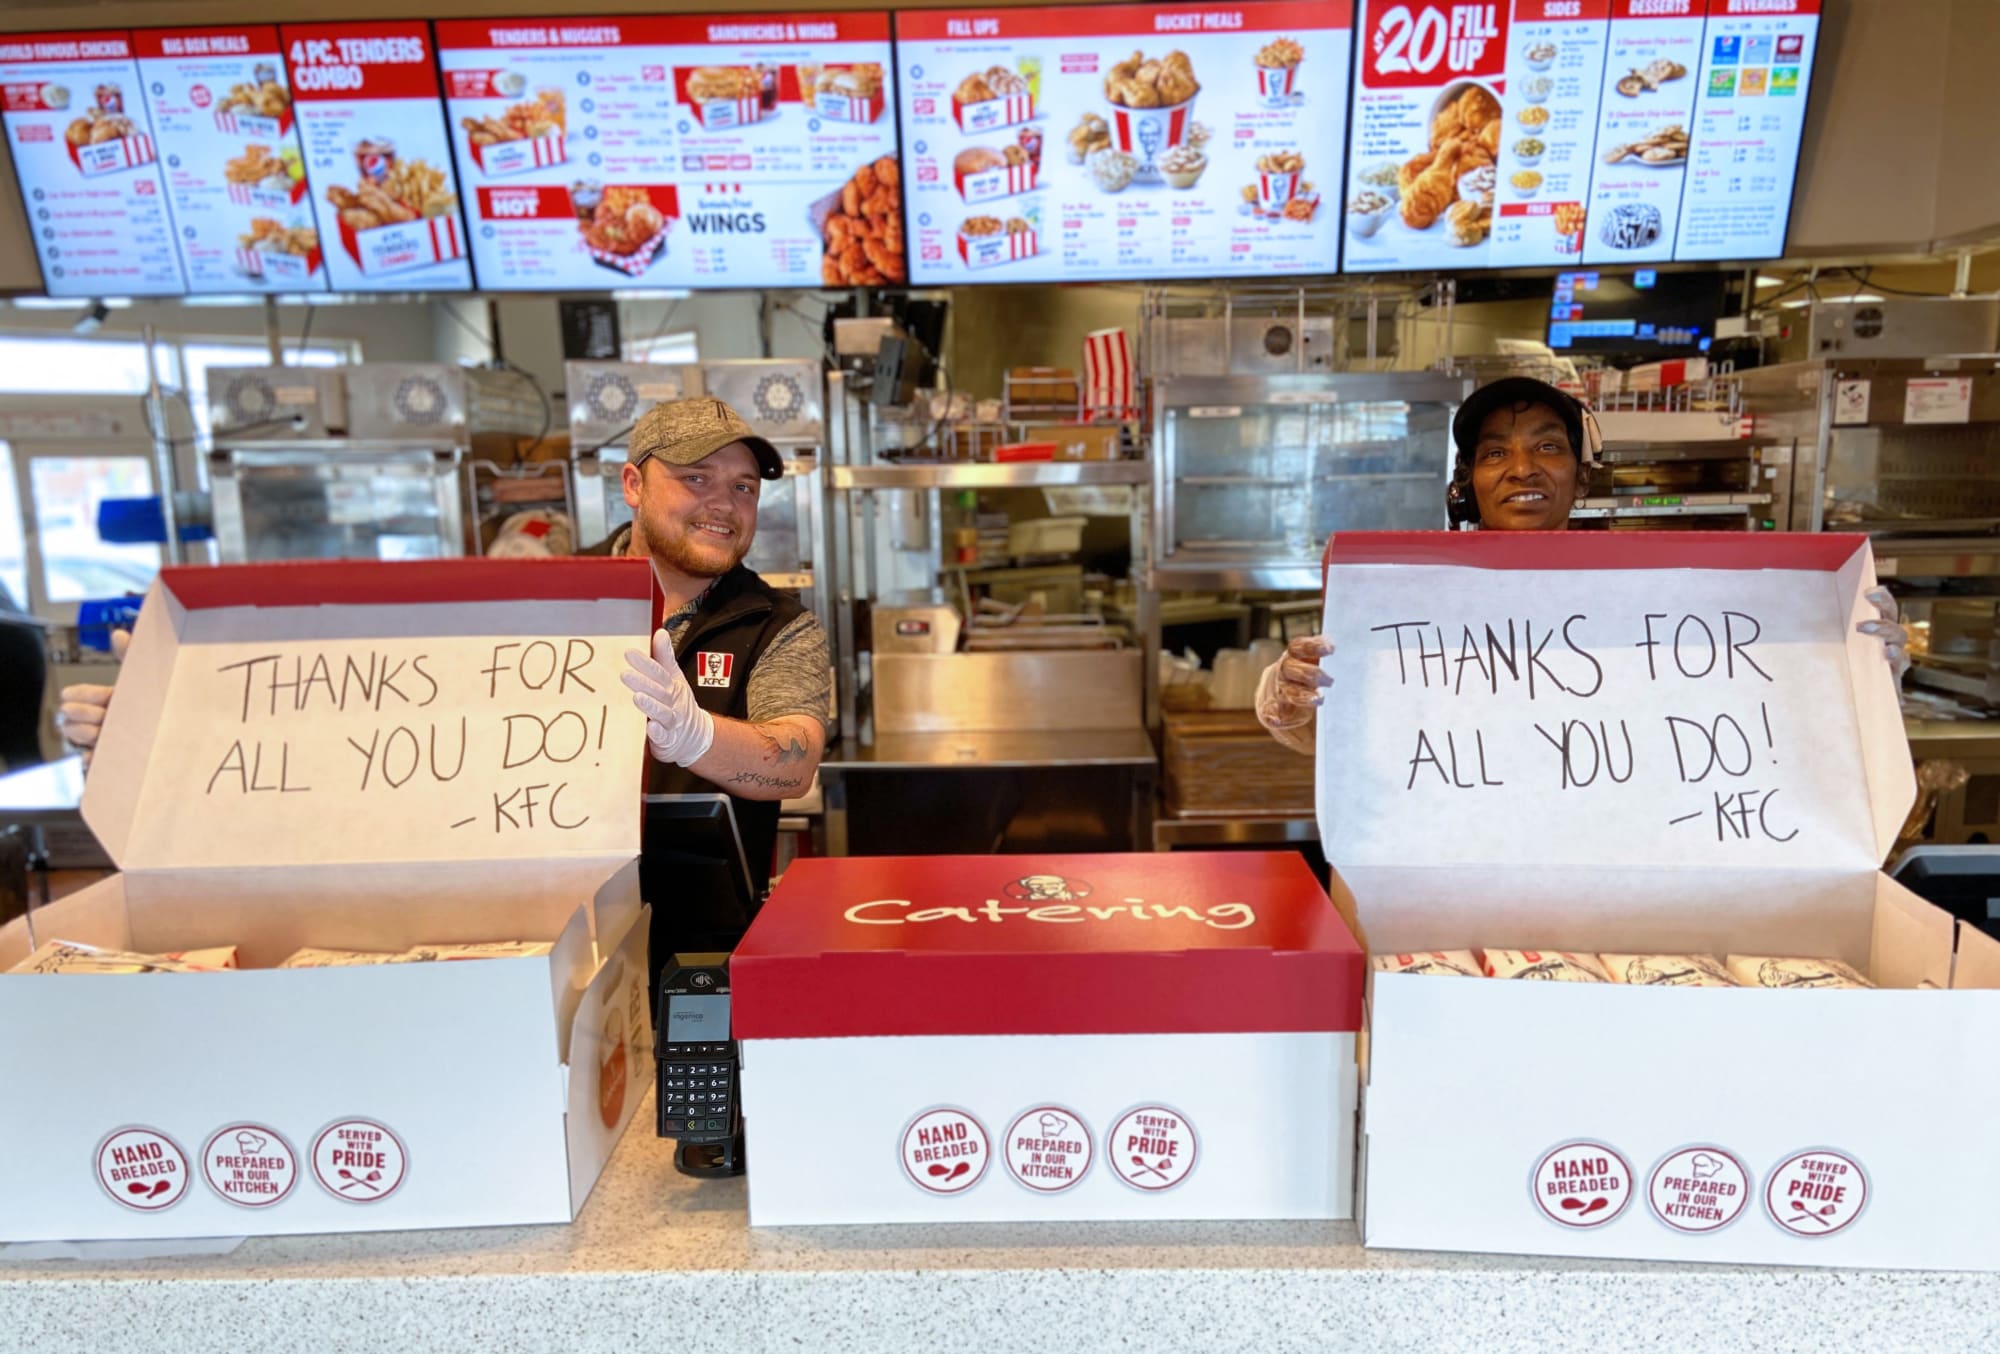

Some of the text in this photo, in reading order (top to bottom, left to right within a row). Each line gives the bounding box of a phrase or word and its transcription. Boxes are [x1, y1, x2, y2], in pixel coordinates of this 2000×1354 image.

[1543, 1, 1581, 17] SIDES
[1629, 0, 1691, 16] DESSERTS
[947, 18, 999, 37] FILL UPS
[1155, 12, 1243, 31] BUCKET MEALS
[1452, 4, 1498, 38] FILL
[489, 29, 547, 46] TENDERS
[560, 26, 621, 44] NUGGETS
[707, 24, 785, 41] SANDWICHES
[797, 22, 838, 40] WINGS
[1373, 5, 1448, 76] $20
[80, 40, 128, 58] CHICKEN
[161, 38, 184, 55] BIG
[208, 35, 250, 53] MEALS
[336, 36, 426, 64] TENDERS
[1448, 38, 1487, 72] UP
[294, 64, 364, 91] COMBO
[490, 198, 540, 217] HOT
[687, 212, 766, 235] WINGS
[1371, 611, 1773, 699] THANKS FOR
[217, 639, 596, 723] THANKS FOR
[702, 677, 726, 686] KFC
[206, 705, 608, 794] ALL YOU DO!
[1407, 701, 1779, 790] ALL YOU DO!
[843, 897, 1256, 930] Catering
[1135, 1115, 1177, 1129] SERVED
[338, 1129, 382, 1142] SERVED
[917, 1122, 967, 1146] HAND
[1143, 1127, 1167, 1138] WITH
[111, 1141, 163, 1165] HAND
[346, 1140, 373, 1150] WITH
[913, 1141, 979, 1163] BREADED
[1017, 1137, 1082, 1154] PREPARED
[1127, 1135, 1179, 1157] PRIDE
[216, 1155, 285, 1171] PREPARED
[331, 1149, 386, 1169] PRIDE
[1031, 1152, 1066, 1165] IN OUR
[1553, 1157, 1609, 1179] HAND
[1800, 1159, 1848, 1175] SERVED
[110, 1159, 177, 1182] BREADED
[233, 1169, 270, 1181] IN OUR
[1021, 1163, 1073, 1179] KITCHEN
[1807, 1171, 1835, 1183] WITH
[223, 1180, 279, 1194] KITCHEN
[1547, 1177, 1620, 1195] BREADED
[1663, 1177, 1737, 1196] PREPARED
[1787, 1180, 1847, 1204] PRIDE
[1678, 1192, 1717, 1207] IN OUR
[1665, 1203, 1723, 1221] KITCHEN
